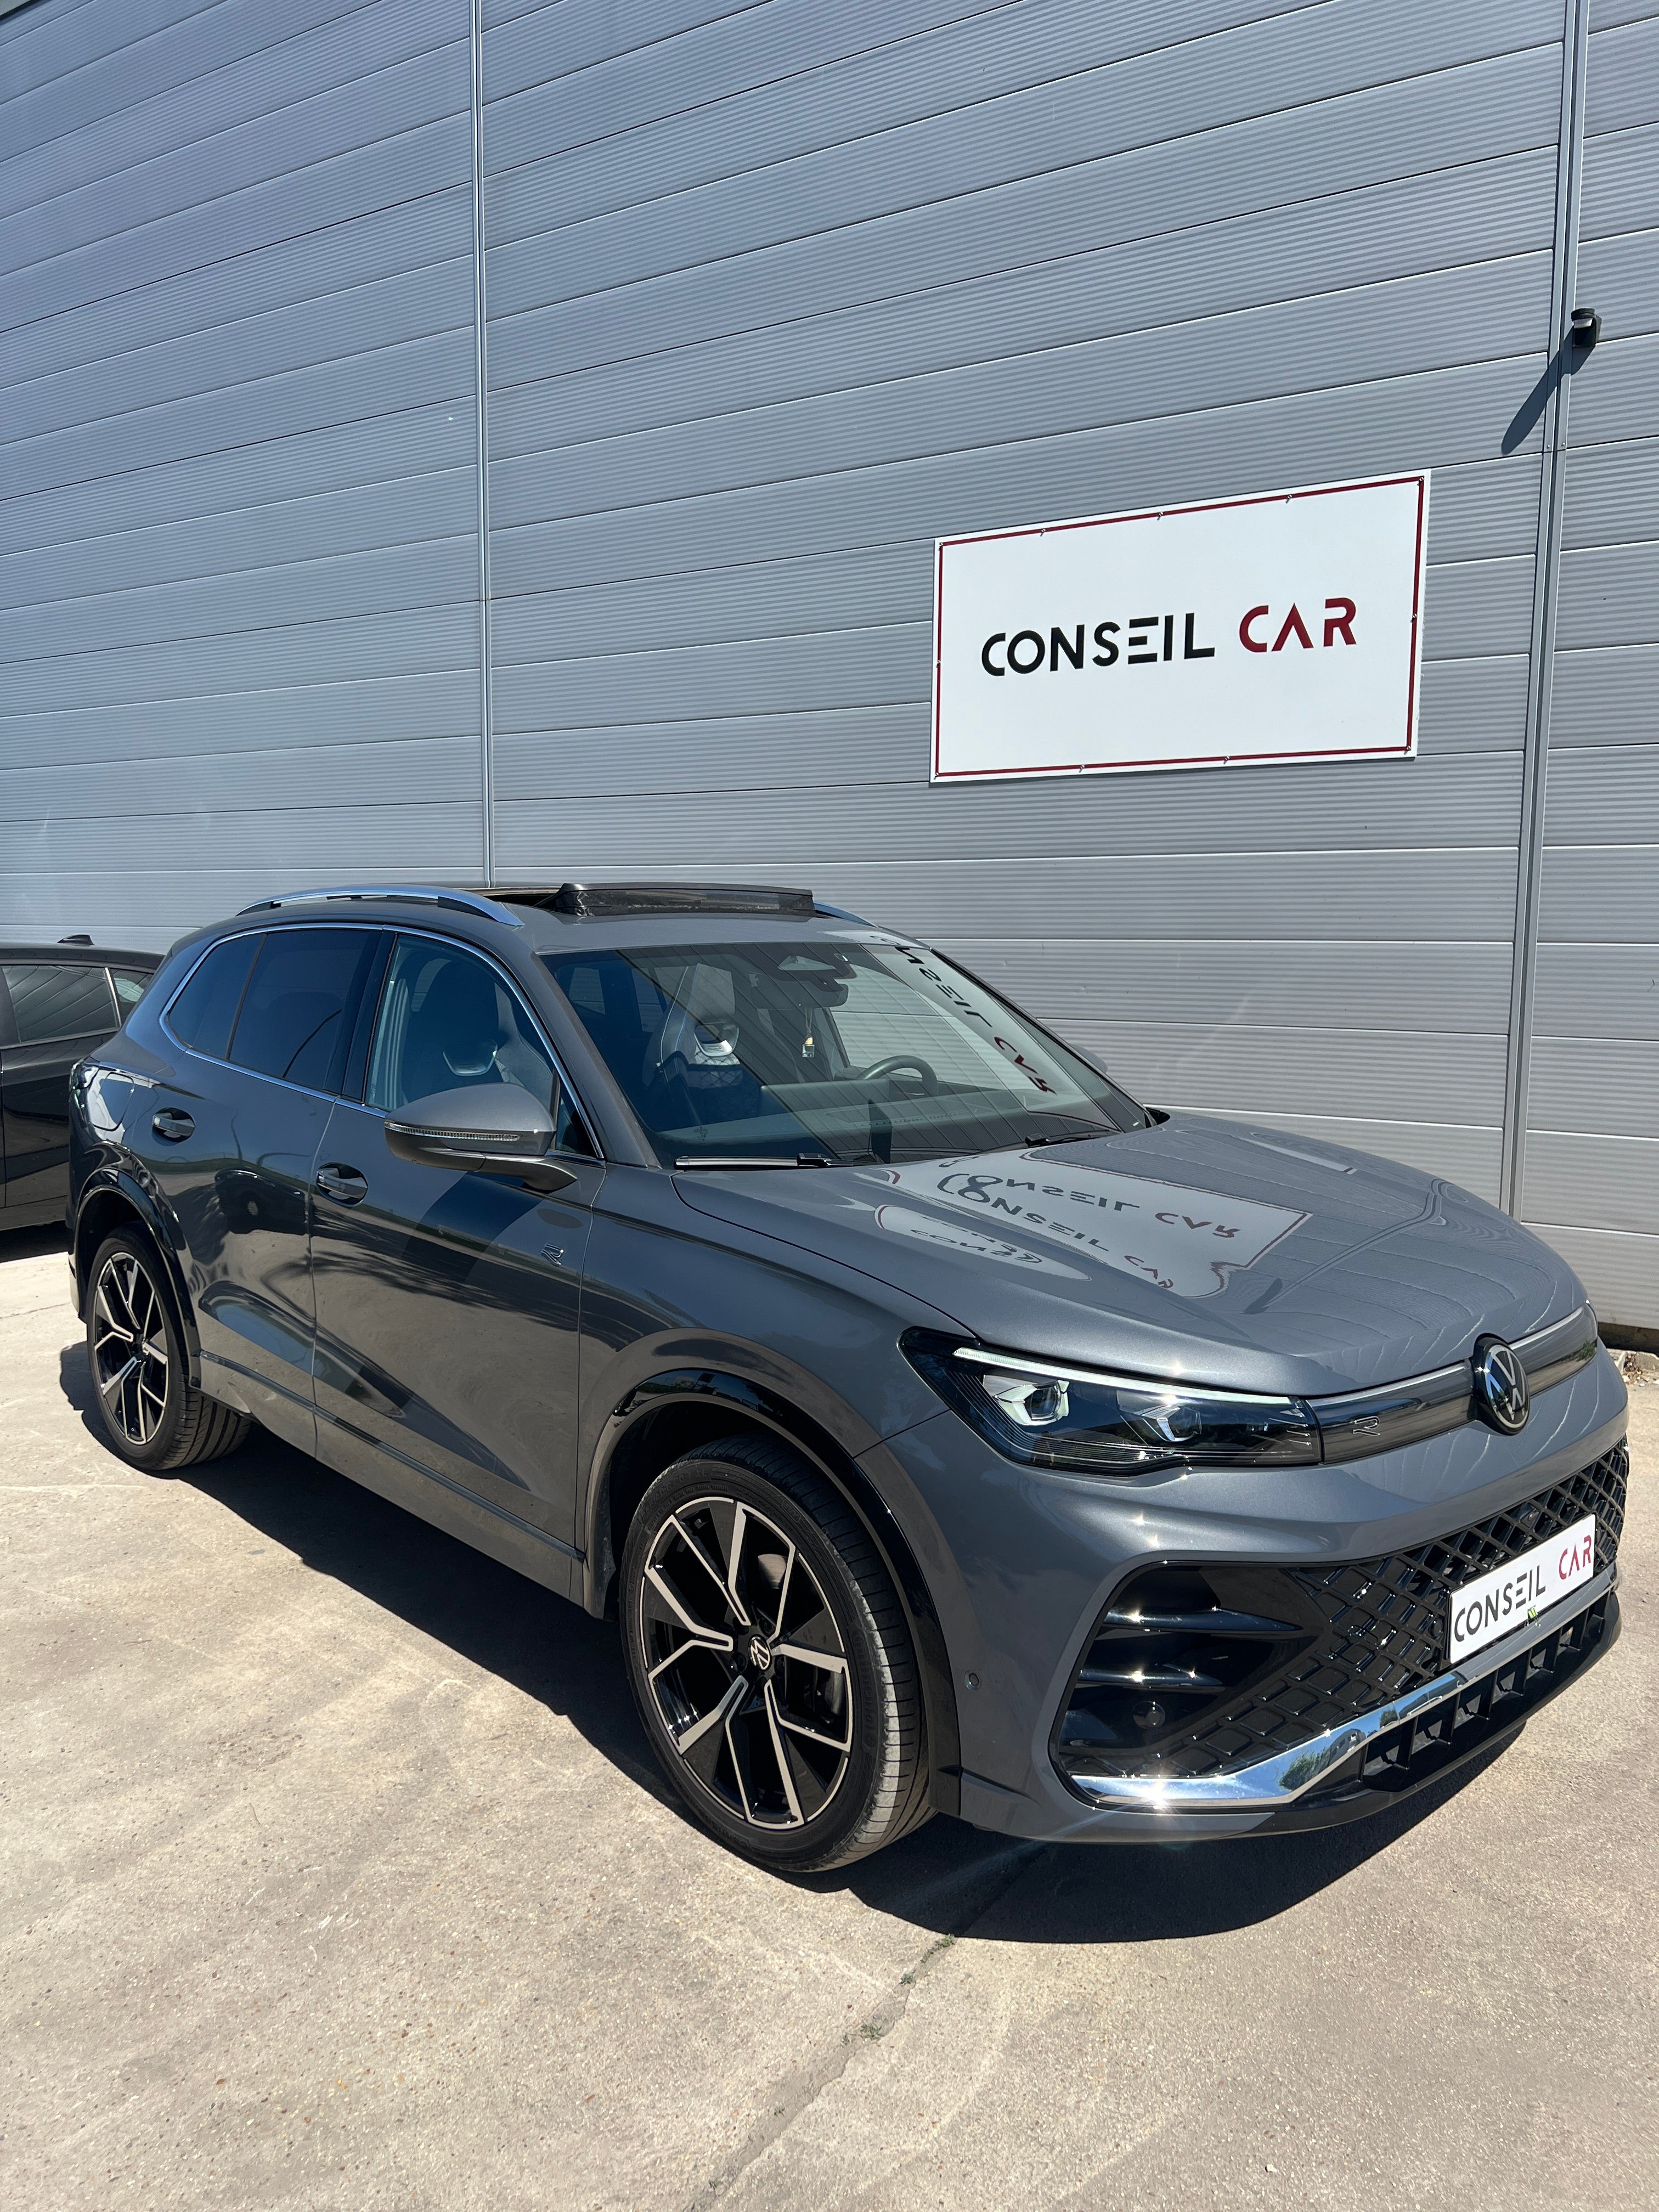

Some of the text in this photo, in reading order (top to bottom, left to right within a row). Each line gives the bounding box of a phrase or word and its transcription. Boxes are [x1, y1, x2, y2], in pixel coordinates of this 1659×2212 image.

[981, 597, 1357, 676] CONSEIL CAR
[1454, 1534, 1592, 1643] CONSEIL CAR
